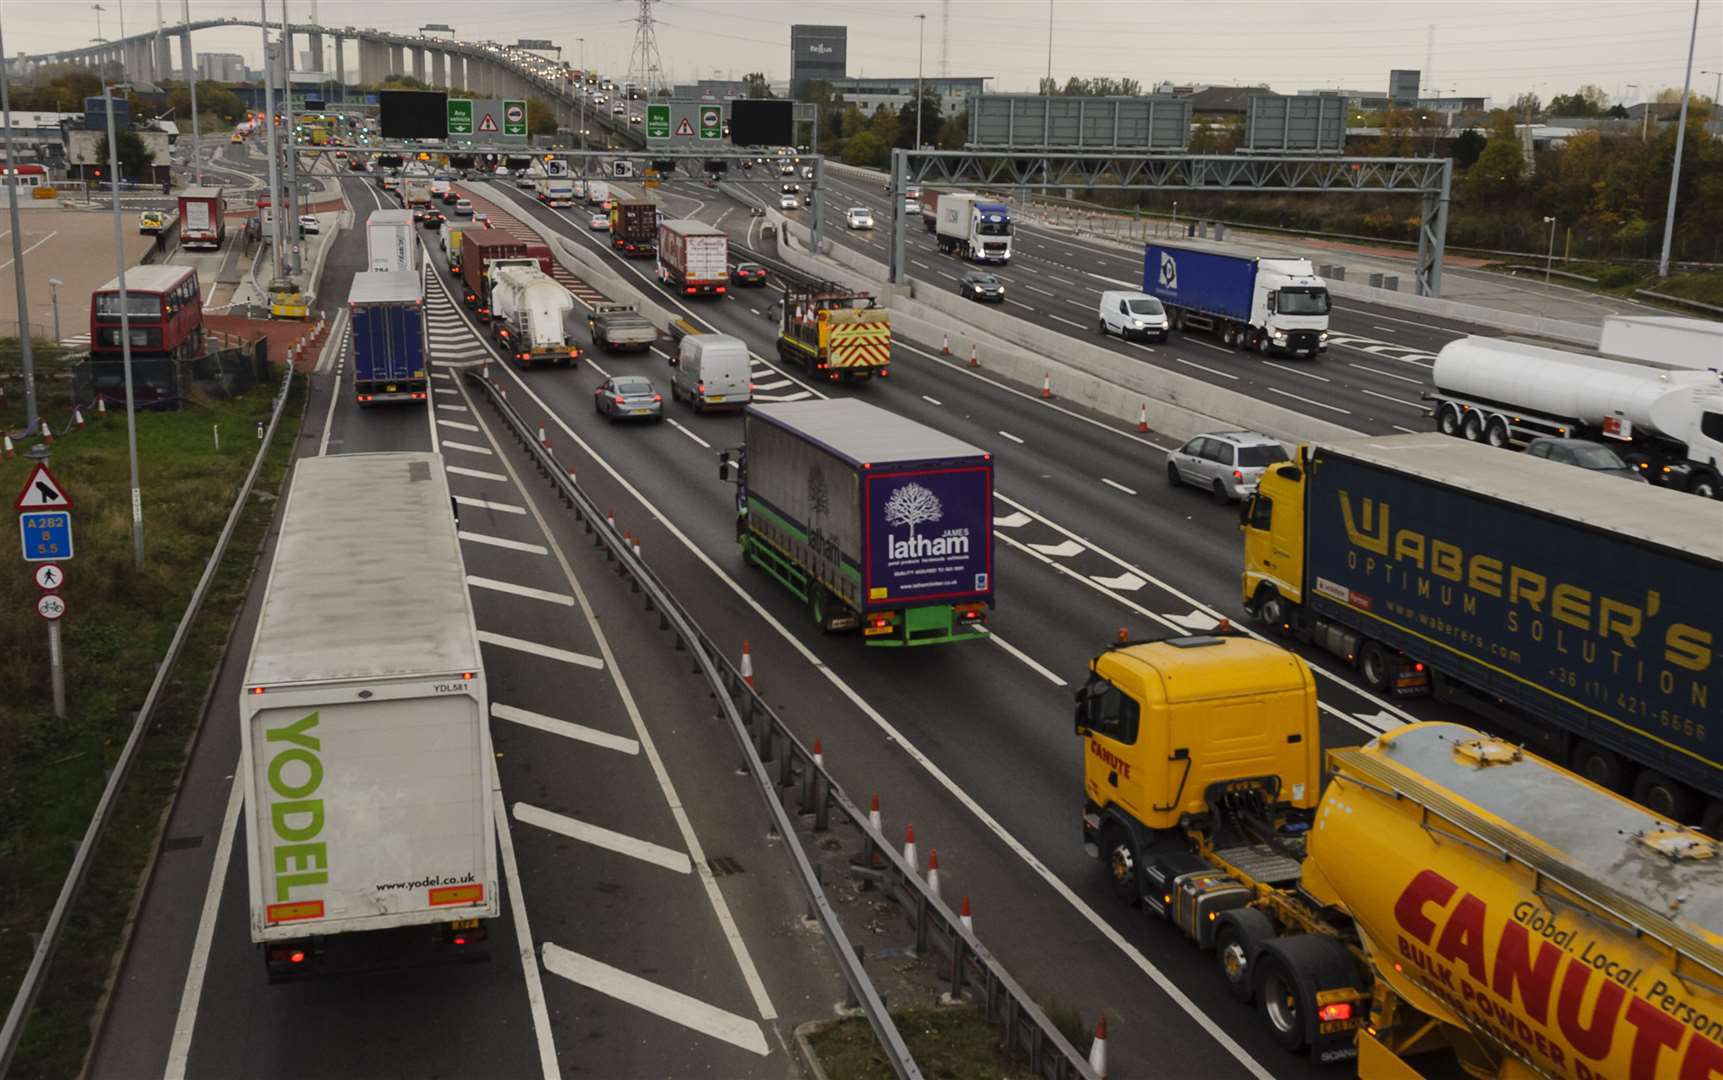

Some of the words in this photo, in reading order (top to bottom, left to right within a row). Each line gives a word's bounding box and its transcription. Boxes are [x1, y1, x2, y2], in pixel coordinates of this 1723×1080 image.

[28, 518, 36, 528] A
[38, 517, 64, 528] 282
[888, 534, 969, 559] latham
[942, 528, 969, 538] JAMES
[1348, 550, 1477, 616] OPTIMUM
[1508, 612, 1708, 709] SOLUTION
[1091, 739, 1131, 780] CANUTE
[266, 711, 328, 902] YODEL
[376, 872, 475, 890] www.yodel.co.uk
[1513, 901, 1578, 953] Global.
[1580, 941, 1642, 992] Local.
[1646, 980, 1723, 1045] Person
[1398, 935, 1455, 991] BULK
[1460, 978, 1568, 1070] POWDER
